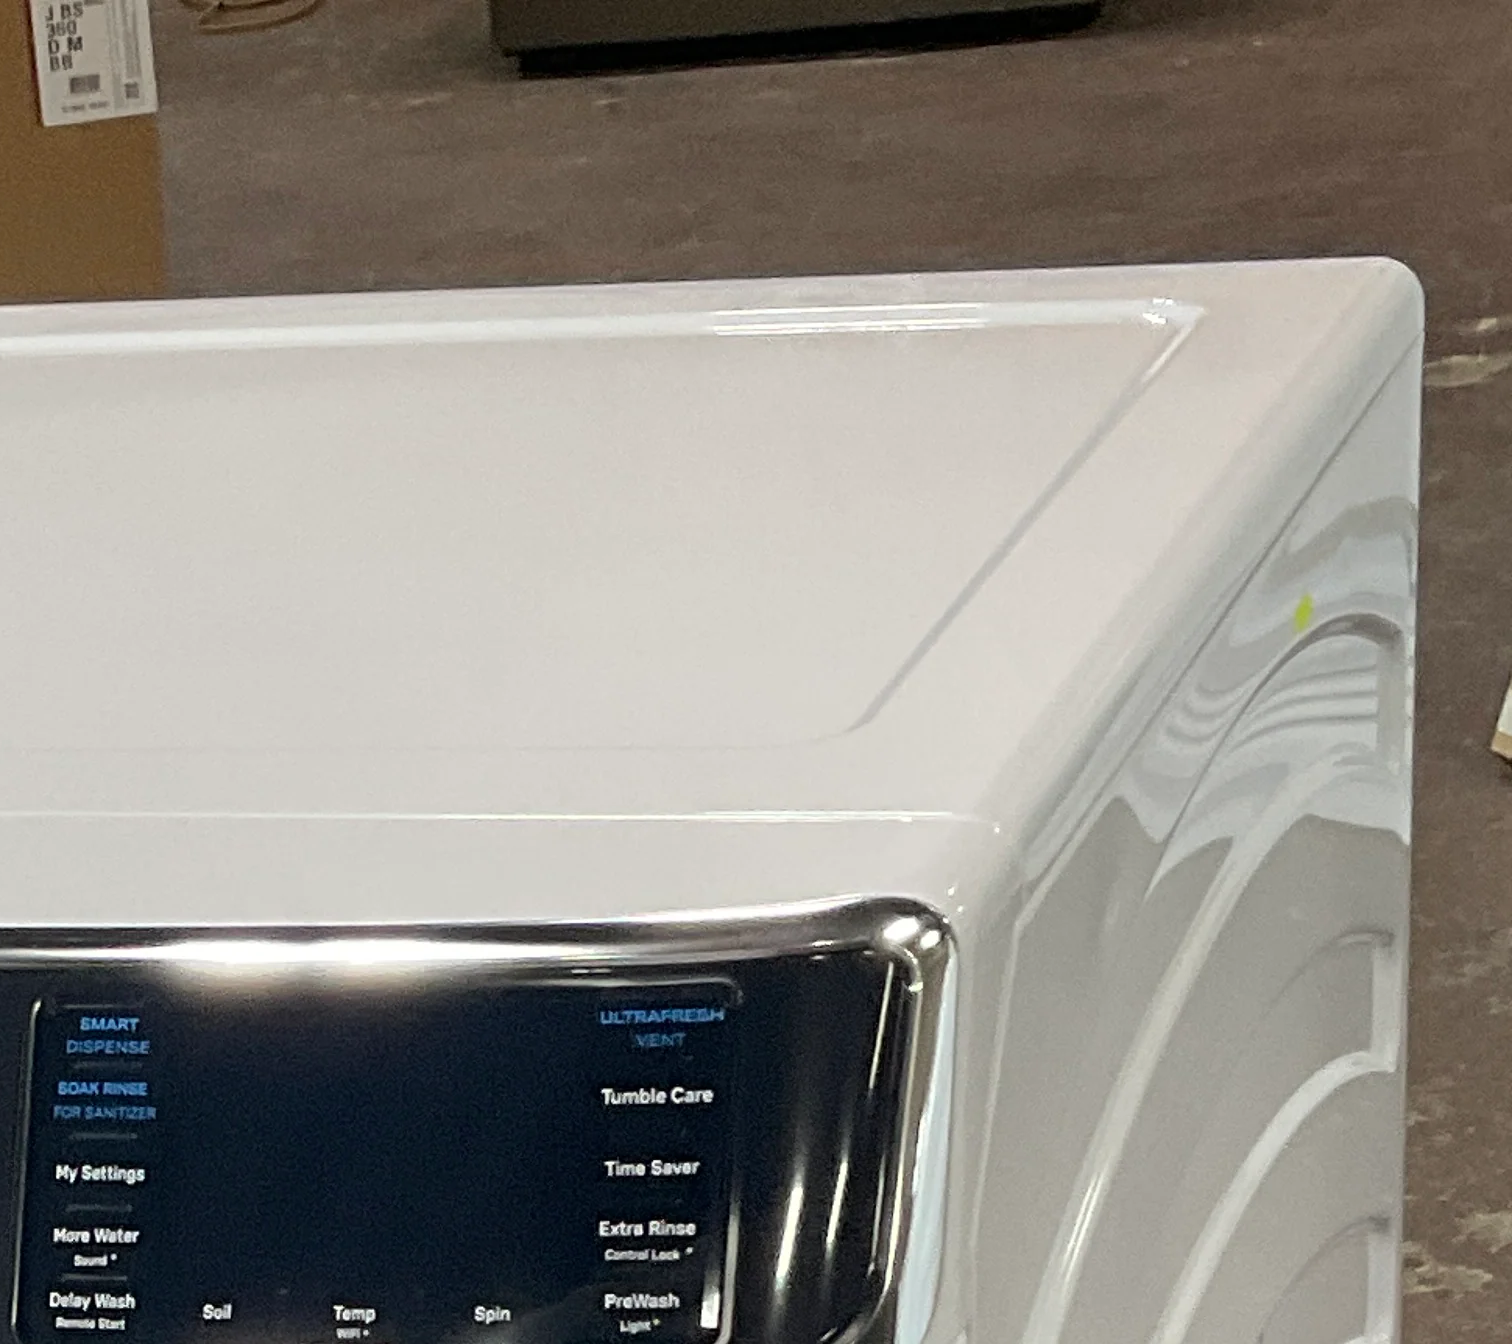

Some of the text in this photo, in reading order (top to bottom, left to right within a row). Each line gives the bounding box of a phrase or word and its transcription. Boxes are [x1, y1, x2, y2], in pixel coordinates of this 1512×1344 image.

[79, 1016, 141, 1032] SMART
[599, 1007, 726, 1025] ULTRAFRESH
[66, 1039, 151, 1056] DISPENSE
[635, 1032, 687, 1048] VENT
[57, 1080, 149, 1097] SOAK RINSE
[600, 1086, 715, 1106] Tumble Care
[53, 1104, 157, 1121] FOR SANITIZER
[55, 1163, 147, 1186] My Settings
[603, 1159, 701, 1177] Time Saver
[52, 1227, 141, 1244] More Water
[598, 1220, 698, 1238] Extra Rinse
[49, 1291, 137, 1312] Delay Wash
[603, 1293, 681, 1310] PreWash
[202, 1303, 233, 1321] Soil
[333, 1304, 376, 1325] Temp
[473, 1305, 511, 1325] Spin
